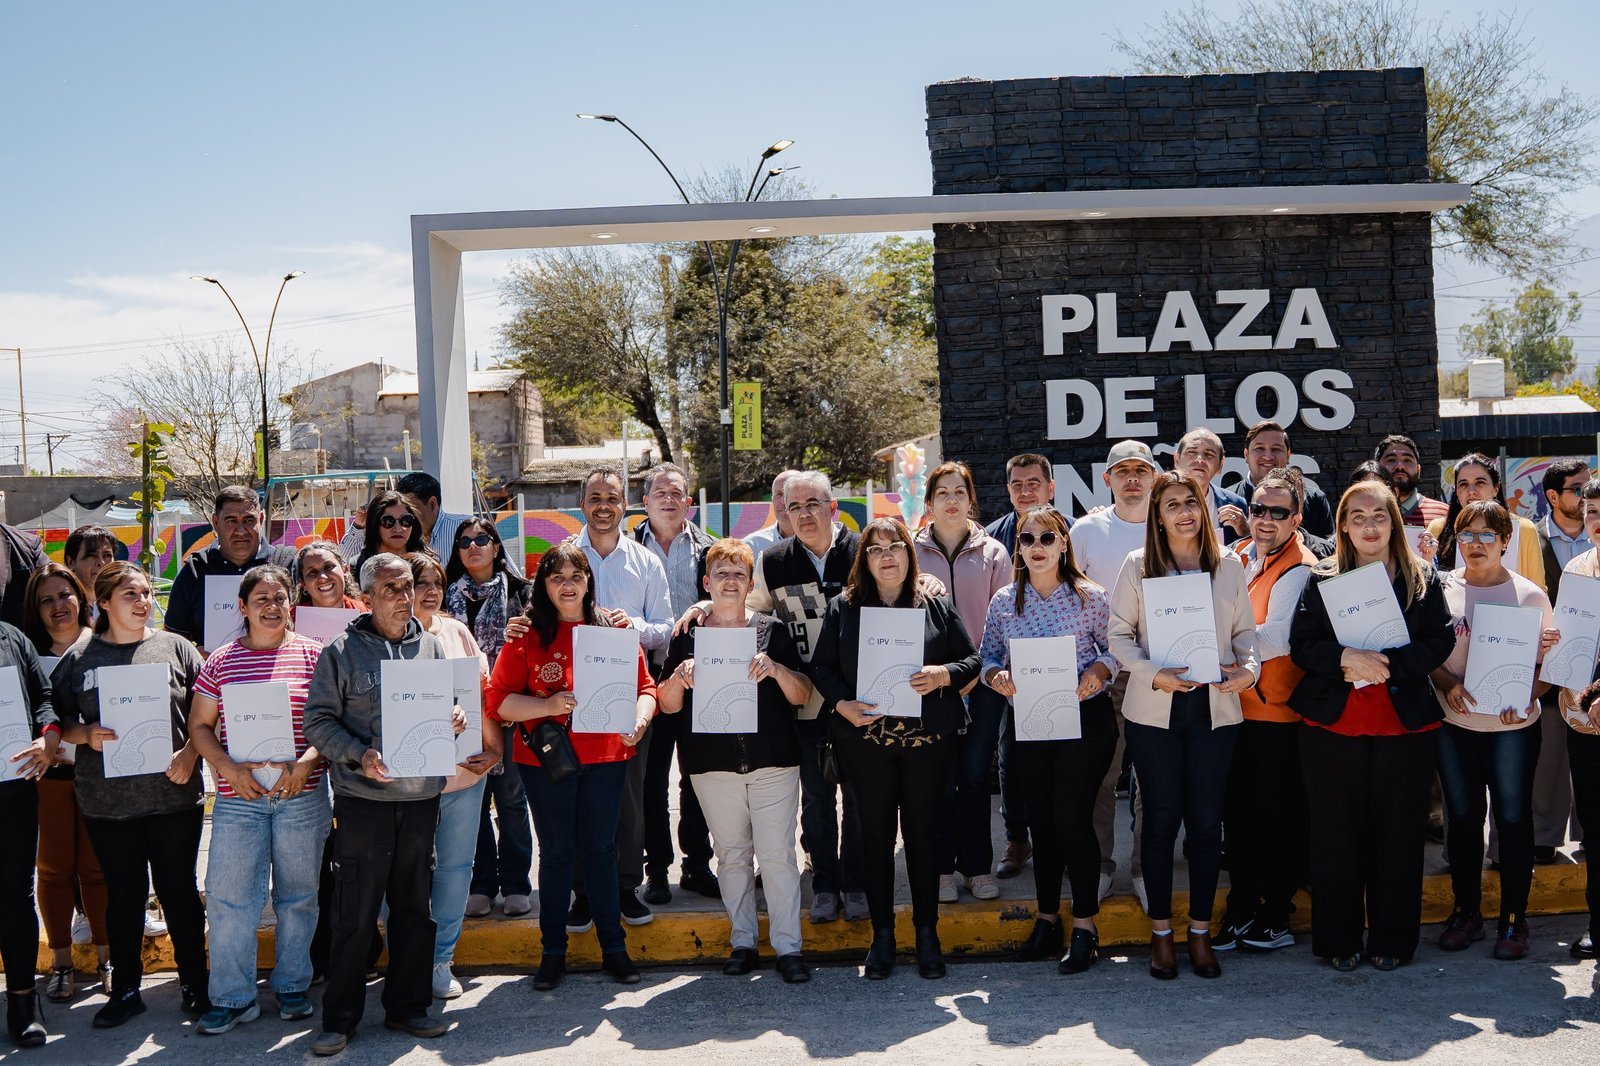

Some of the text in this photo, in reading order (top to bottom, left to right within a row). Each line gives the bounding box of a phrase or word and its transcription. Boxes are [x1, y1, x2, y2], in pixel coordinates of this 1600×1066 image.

[1041, 287, 1338, 356] PLAZA
[1045, 368, 1356, 441] DE LOS
[1164, 607, 1178, 615] IPV
[1347, 604, 1360, 615] IPV
[1568, 607, 1579, 615] IPV
[711, 657, 724, 665] IPV
[402, 693, 416, 701] IPV
